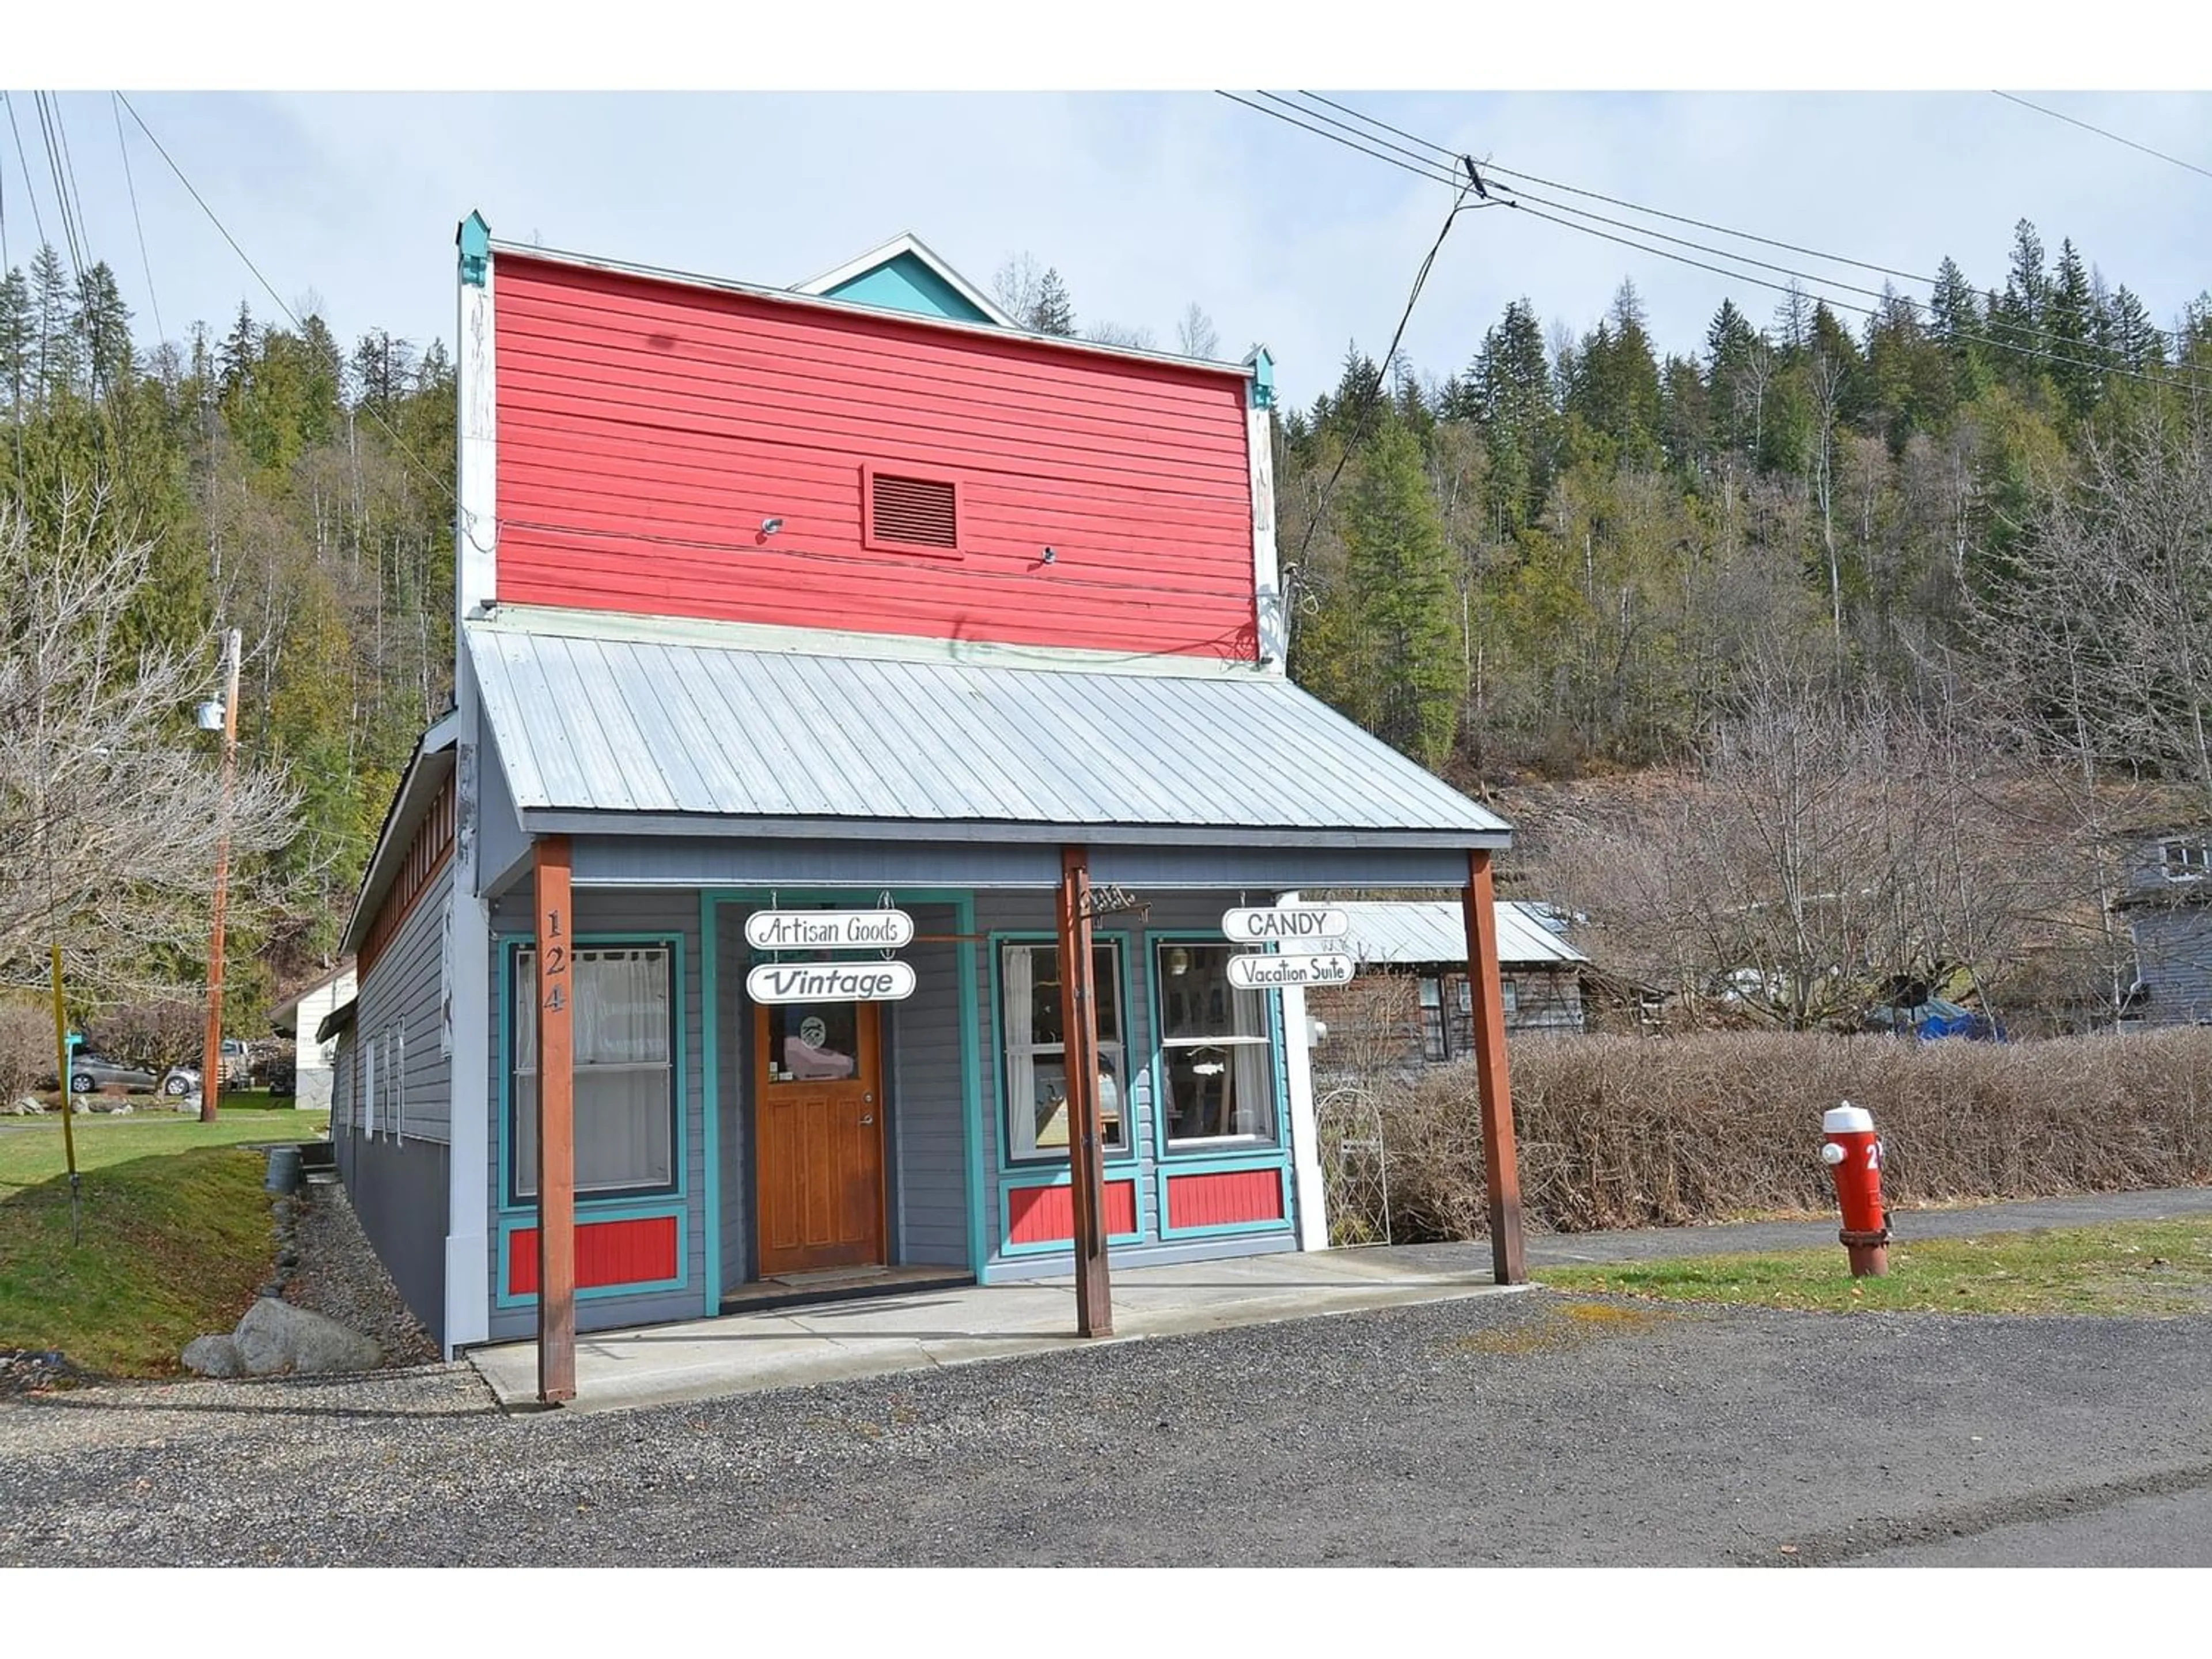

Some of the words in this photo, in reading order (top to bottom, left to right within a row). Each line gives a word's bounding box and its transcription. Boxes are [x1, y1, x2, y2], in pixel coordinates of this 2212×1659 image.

[759, 917, 839, 943] Artisan
[847, 916, 898, 942] Goods
[1247, 912, 1327, 935] CANDY
[1241, 960, 1307, 983] Vacation
[1310, 957, 1345, 979] Suite
[764, 970, 893, 998] Vintage
